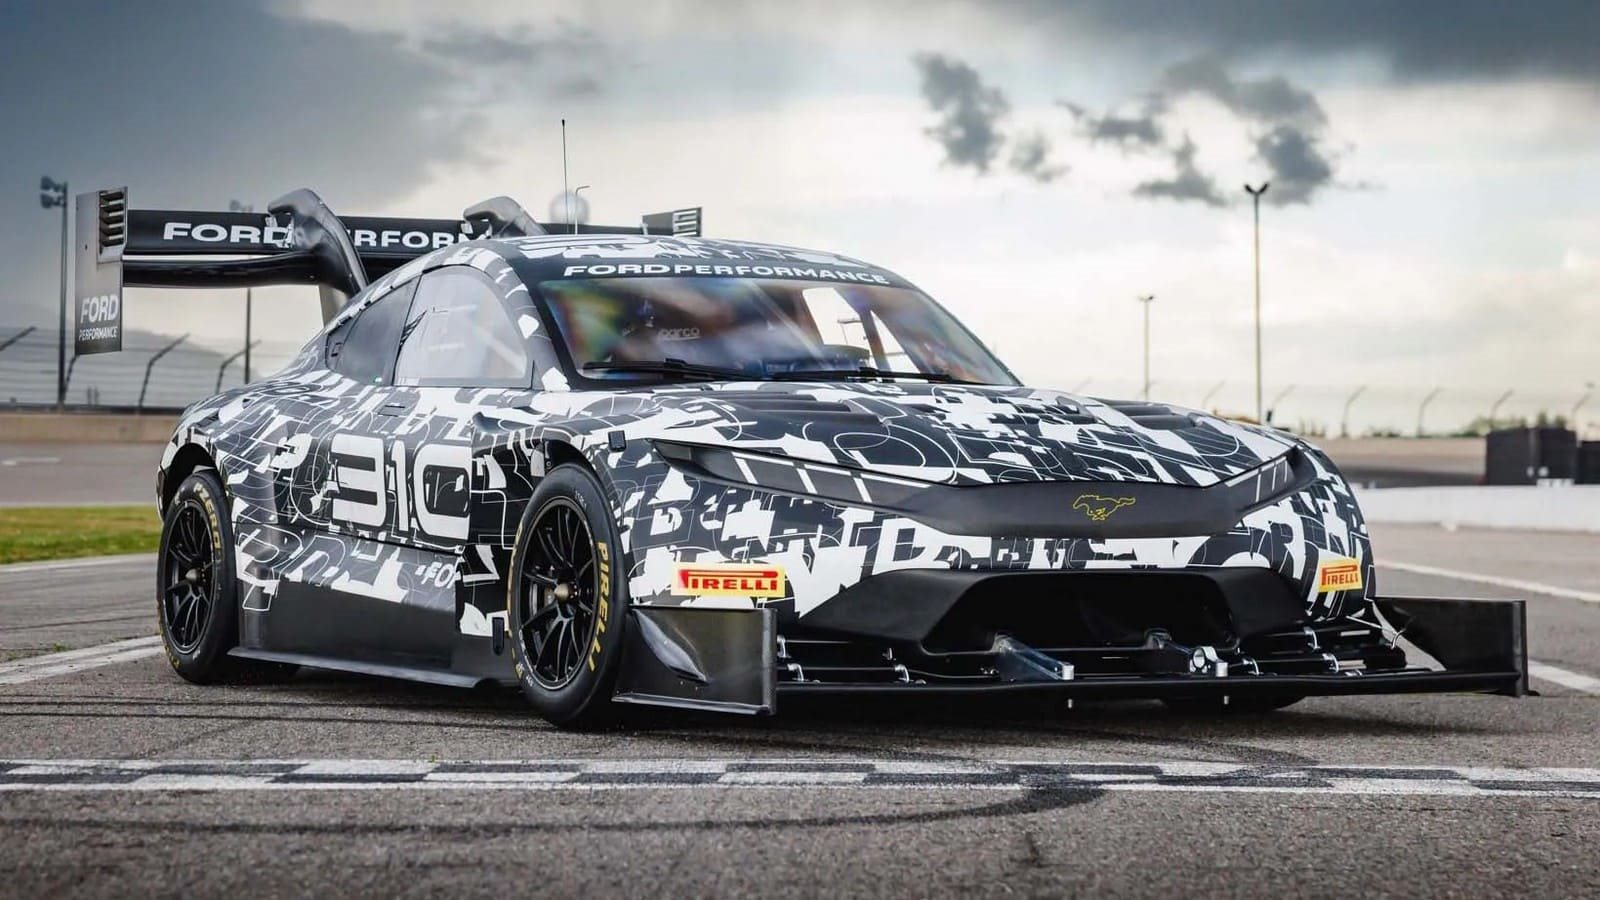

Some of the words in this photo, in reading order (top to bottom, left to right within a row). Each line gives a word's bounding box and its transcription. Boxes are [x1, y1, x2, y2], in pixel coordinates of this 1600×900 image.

[163, 222, 292, 246] FORD
[564, 264, 671, 277] FORD
[674, 265, 890, 285] PERFORMANCE
[80, 294, 119, 323] FORD
[79, 326, 118, 341] PERFORMANCE
[679, 569, 778, 591] PIRELLI
[1321, 564, 1359, 586] PIRELLI
[588, 541, 610, 672] PIRELLI
